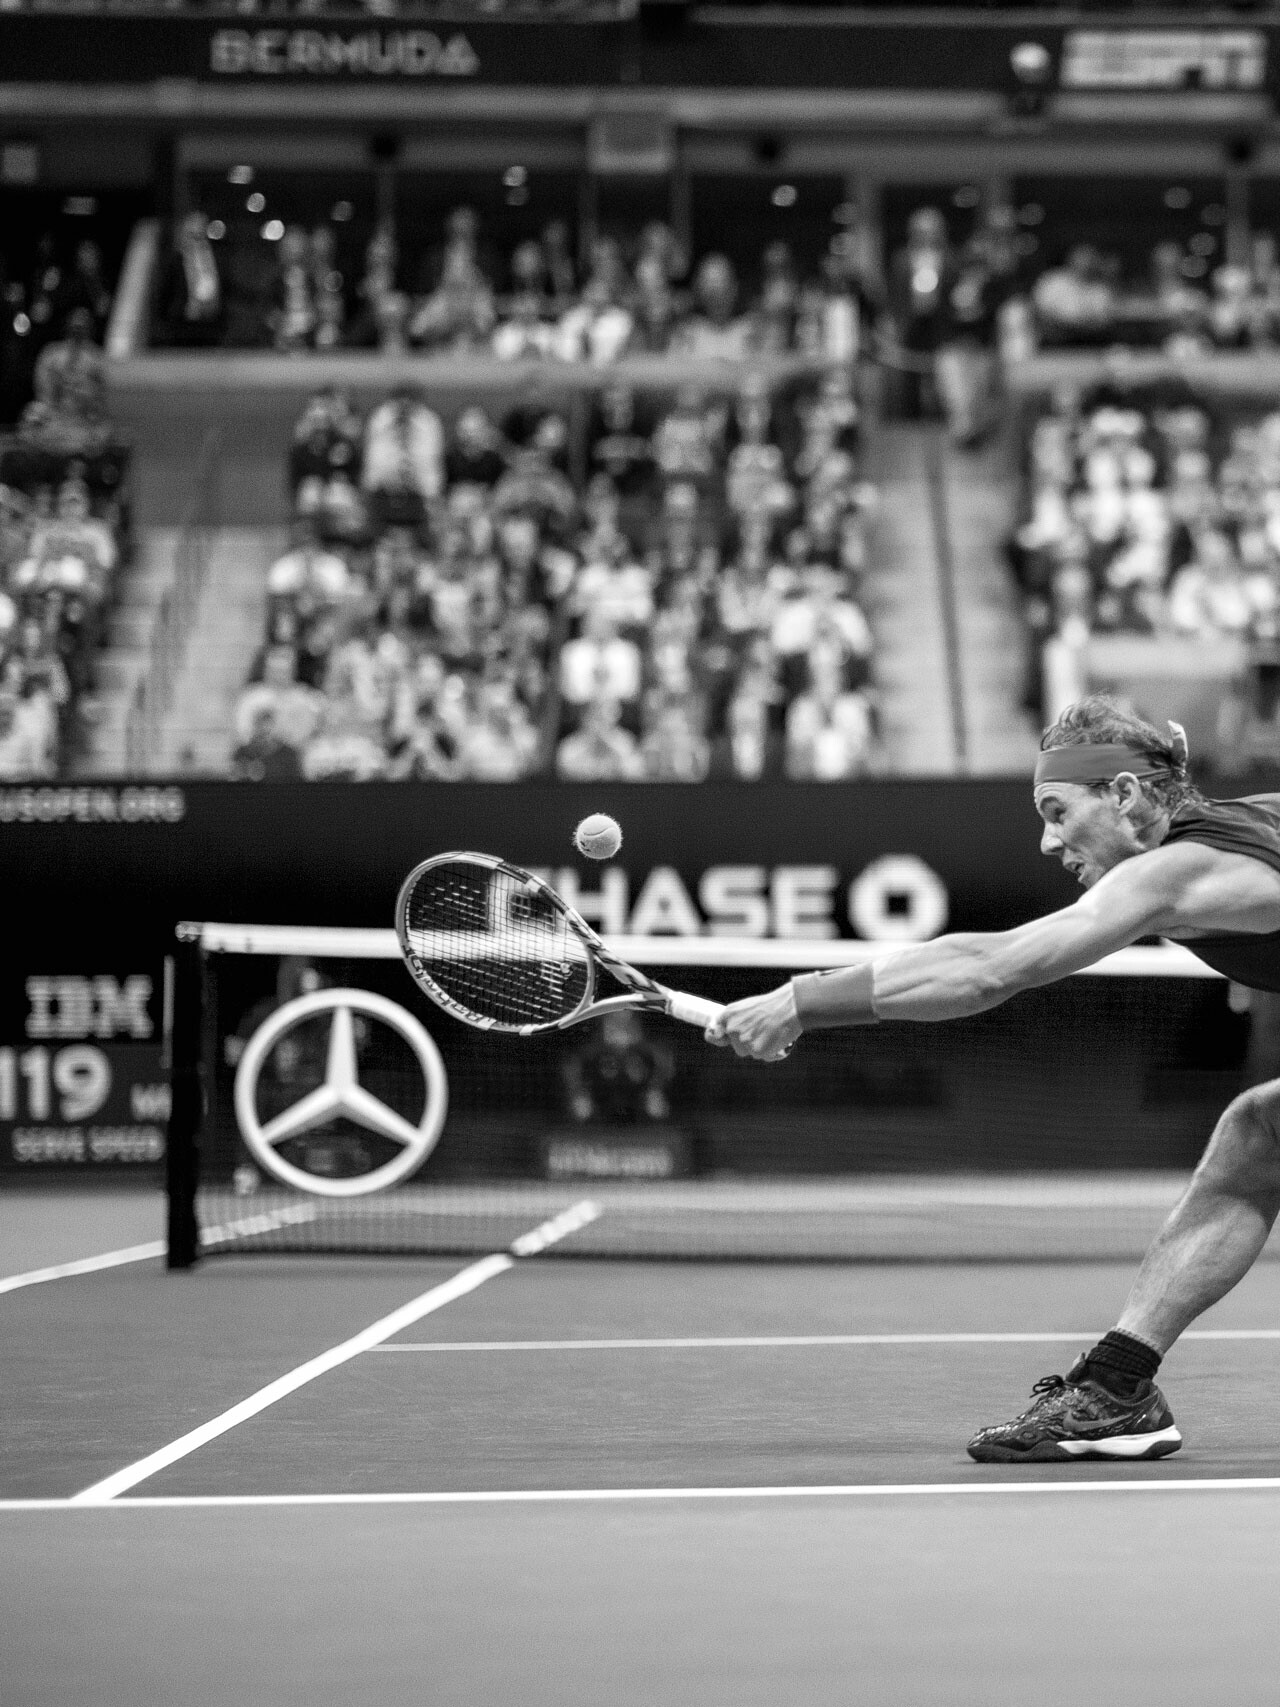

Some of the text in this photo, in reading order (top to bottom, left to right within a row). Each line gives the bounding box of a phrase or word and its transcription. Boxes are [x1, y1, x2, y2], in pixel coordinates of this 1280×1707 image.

[210, 28, 481, 75] BERMUDA
[1061, 29, 1268, 88] ESPN
[25, 975, 153, 1039] IBM
[0, 1045, 112, 1121] 119
[12, 1127, 166, 1161] SERVE SPEED
